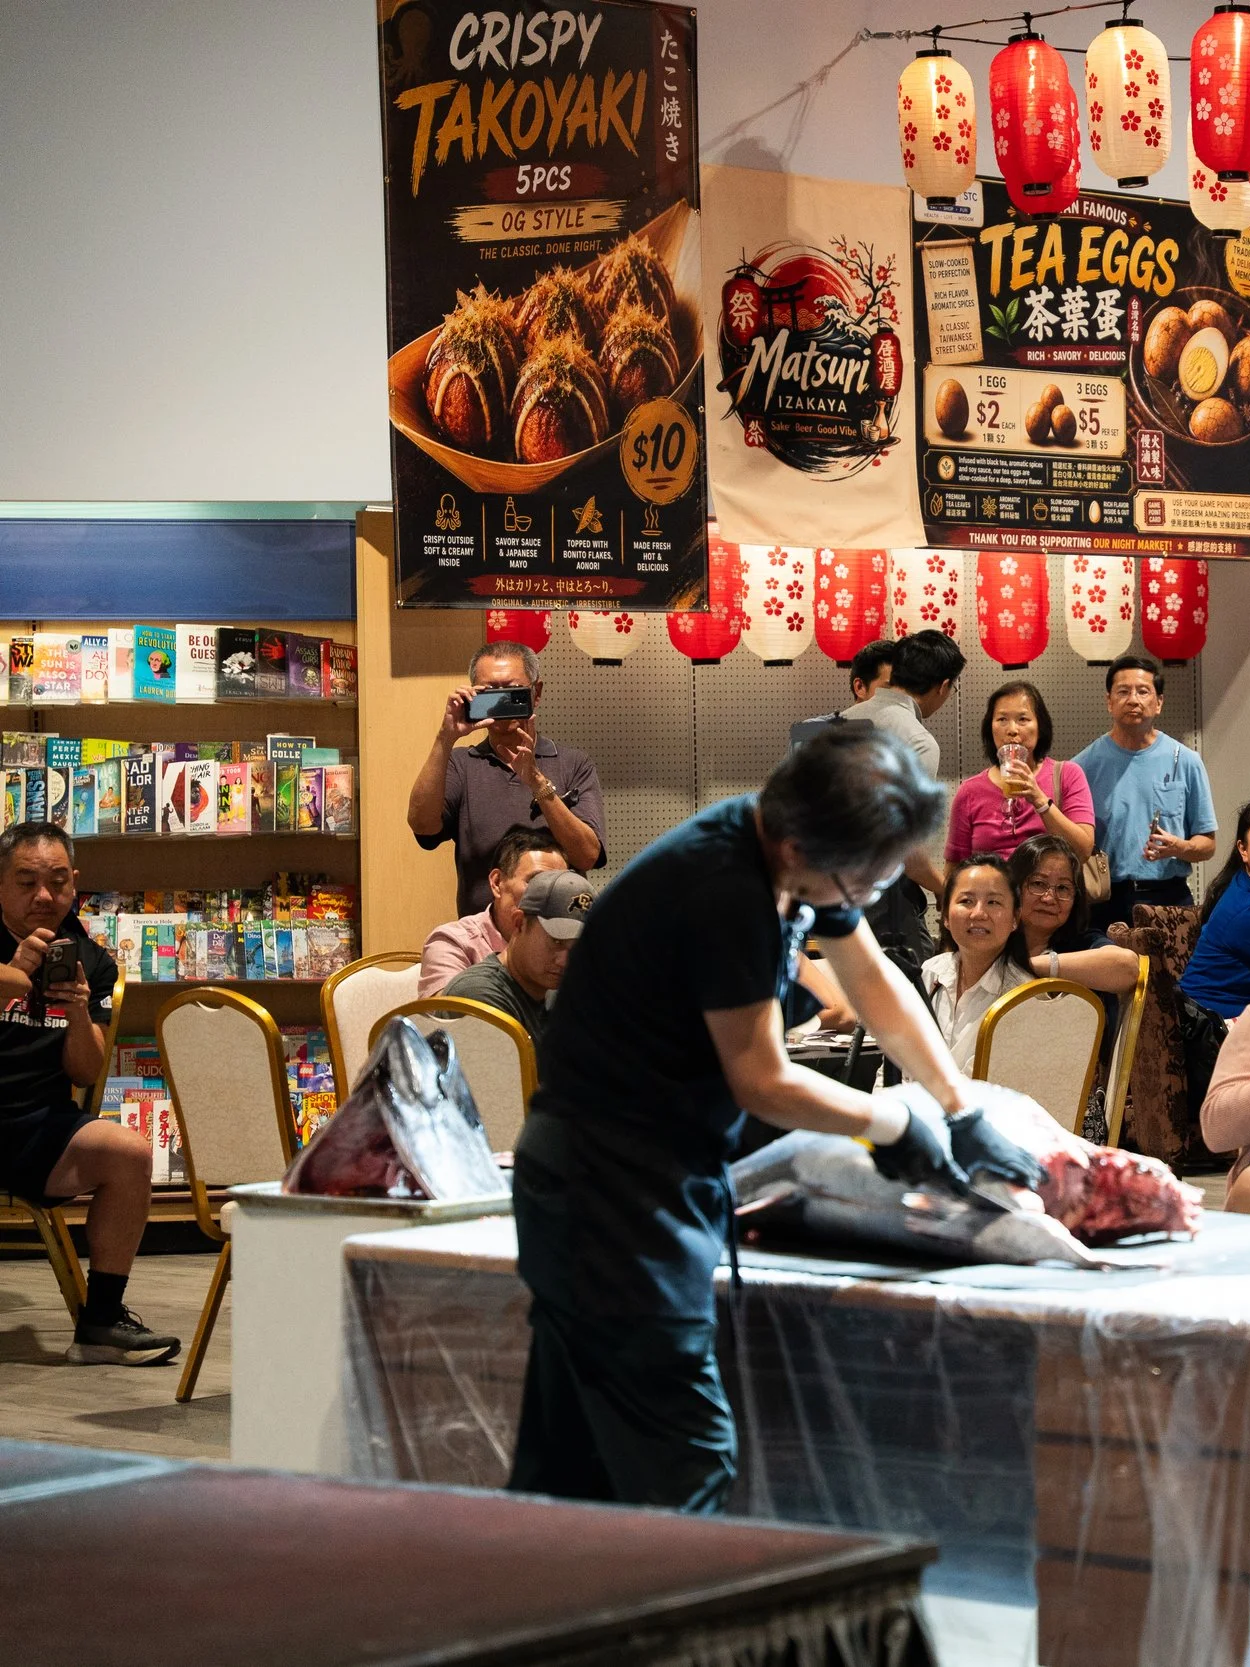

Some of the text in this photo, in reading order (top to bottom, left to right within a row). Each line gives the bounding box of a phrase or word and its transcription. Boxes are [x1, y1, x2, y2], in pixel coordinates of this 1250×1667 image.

[449, 10, 602, 71] CRISPY
[660, 29, 682, 162] たこ焼き
[393, 67, 648, 199] TAKOYAKI
[515, 164, 572, 195] 5PCS
[964, 192, 978, 202] STC
[1083, 200, 1128, 226] FAMOUS
[501, 208, 585, 232] OG STYLE
[479, 239, 603, 260] THE CLASSIC. DONE RIGHT.
[928, 258, 969, 269] SLOW-COOKED
[980, 222, 1180, 298] TEA EGGS
[1231, 257, 1235, 265] A
[929, 268, 971, 279] TO PERFECTION
[934, 289, 969, 300] RICH FLAVOR
[730, 289, 758, 330] 祭
[931, 300, 975, 311] AROMATIC SPICES
[1022, 286, 1126, 342] 茶葉蛋
[940, 322, 970, 332] A CLASSIC
[939, 332, 972, 343] TAIWANESE
[936, 343, 978, 355] STREET SNACK!
[1027, 351, 1126, 362] RICH SAVORY DELICIOUS
[877, 339, 895, 390] 居酒屋
[721, 328, 870, 420] Matsuri
[978, 375, 1007, 389] 1 EGG
[1077, 383, 1108, 396] 3 EGGS
[779, 395, 847, 413] IZAKAYA
[977, 400, 1016, 430] $2 EACH
[1079, 408, 1119, 437] $5 PER SET
[771, 420, 857, 437] Sake Beer Good Vibe
[633, 423, 686, 473] $10
[1217, 501, 1233, 509] POINT
[424, 535, 474, 545] CRISPY OUTSIDE
[496, 538, 541, 547] SAVORY SAUCE
[567, 540, 608, 549] TOPPED WITH
[969, 533, 1173, 551] THANK YOU FOR SUPPORTING OUR NIGHT MARKET!
[424, 547, 474, 556] SOFT & CREAMY
[634, 542, 671, 550] MADE FRESH
[499, 548, 538, 558] & JAPANESE
[563, 551, 613, 561] BONITO FLAKES,
[438, 558, 460, 567] INSIDE
[510, 560, 528, 569] MAYO
[576, 562, 600, 570] AONORI
[637, 563, 669, 571] DELICIOUS
[492, 598, 523, 607] ORIGINAL
[576, 600, 620, 609] IRRESISTIBLE
[84, 638, 100, 646] ALLY
[48, 649, 69, 657] THE
[40, 660, 76, 669] SUN IS
[38, 671, 77, 681] ALSO A
[45, 682, 71, 691] STAR
[272, 750, 300, 759] COLLE
